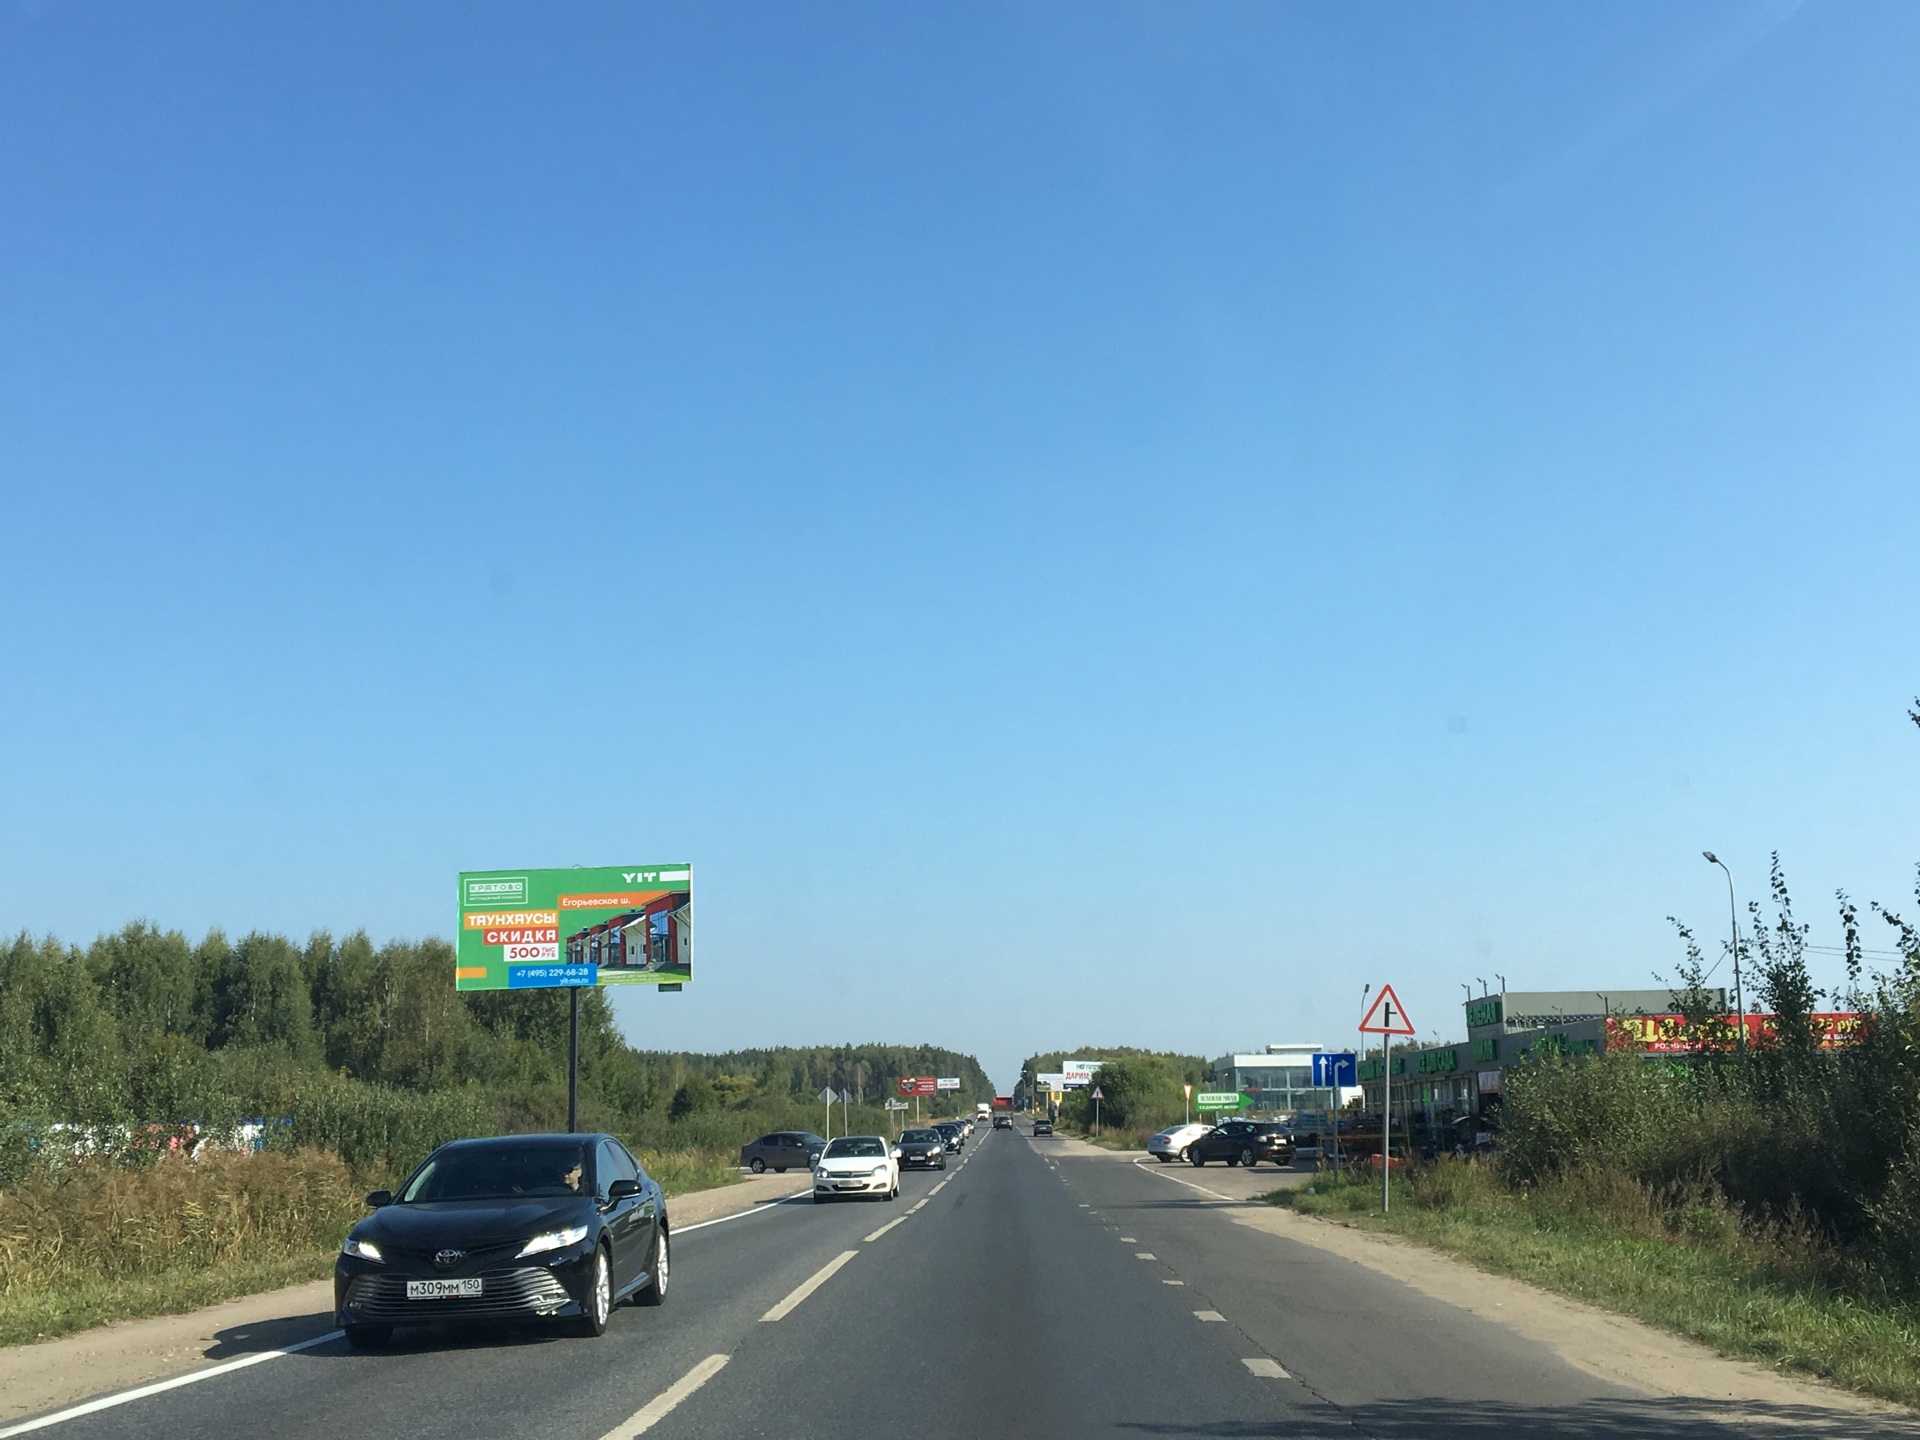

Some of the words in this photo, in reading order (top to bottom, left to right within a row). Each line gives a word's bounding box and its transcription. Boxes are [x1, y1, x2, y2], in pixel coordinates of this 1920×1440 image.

[622, 872, 656, 883] YIT
[470, 883, 522, 892] КРАТОВО
[562, 897, 618, 908] Егорьевское
[620, 897, 631, 905] ш.
[468, 912, 556, 926] ТАУНХАУСЫ
[487, 930, 556, 944] СКИДКА
[509, 947, 540, 959] 500
[527, 970, 547, 978] (495)
[548, 968, 589, 977] 229-68-28
[461, 1279, 480, 1290] 150
